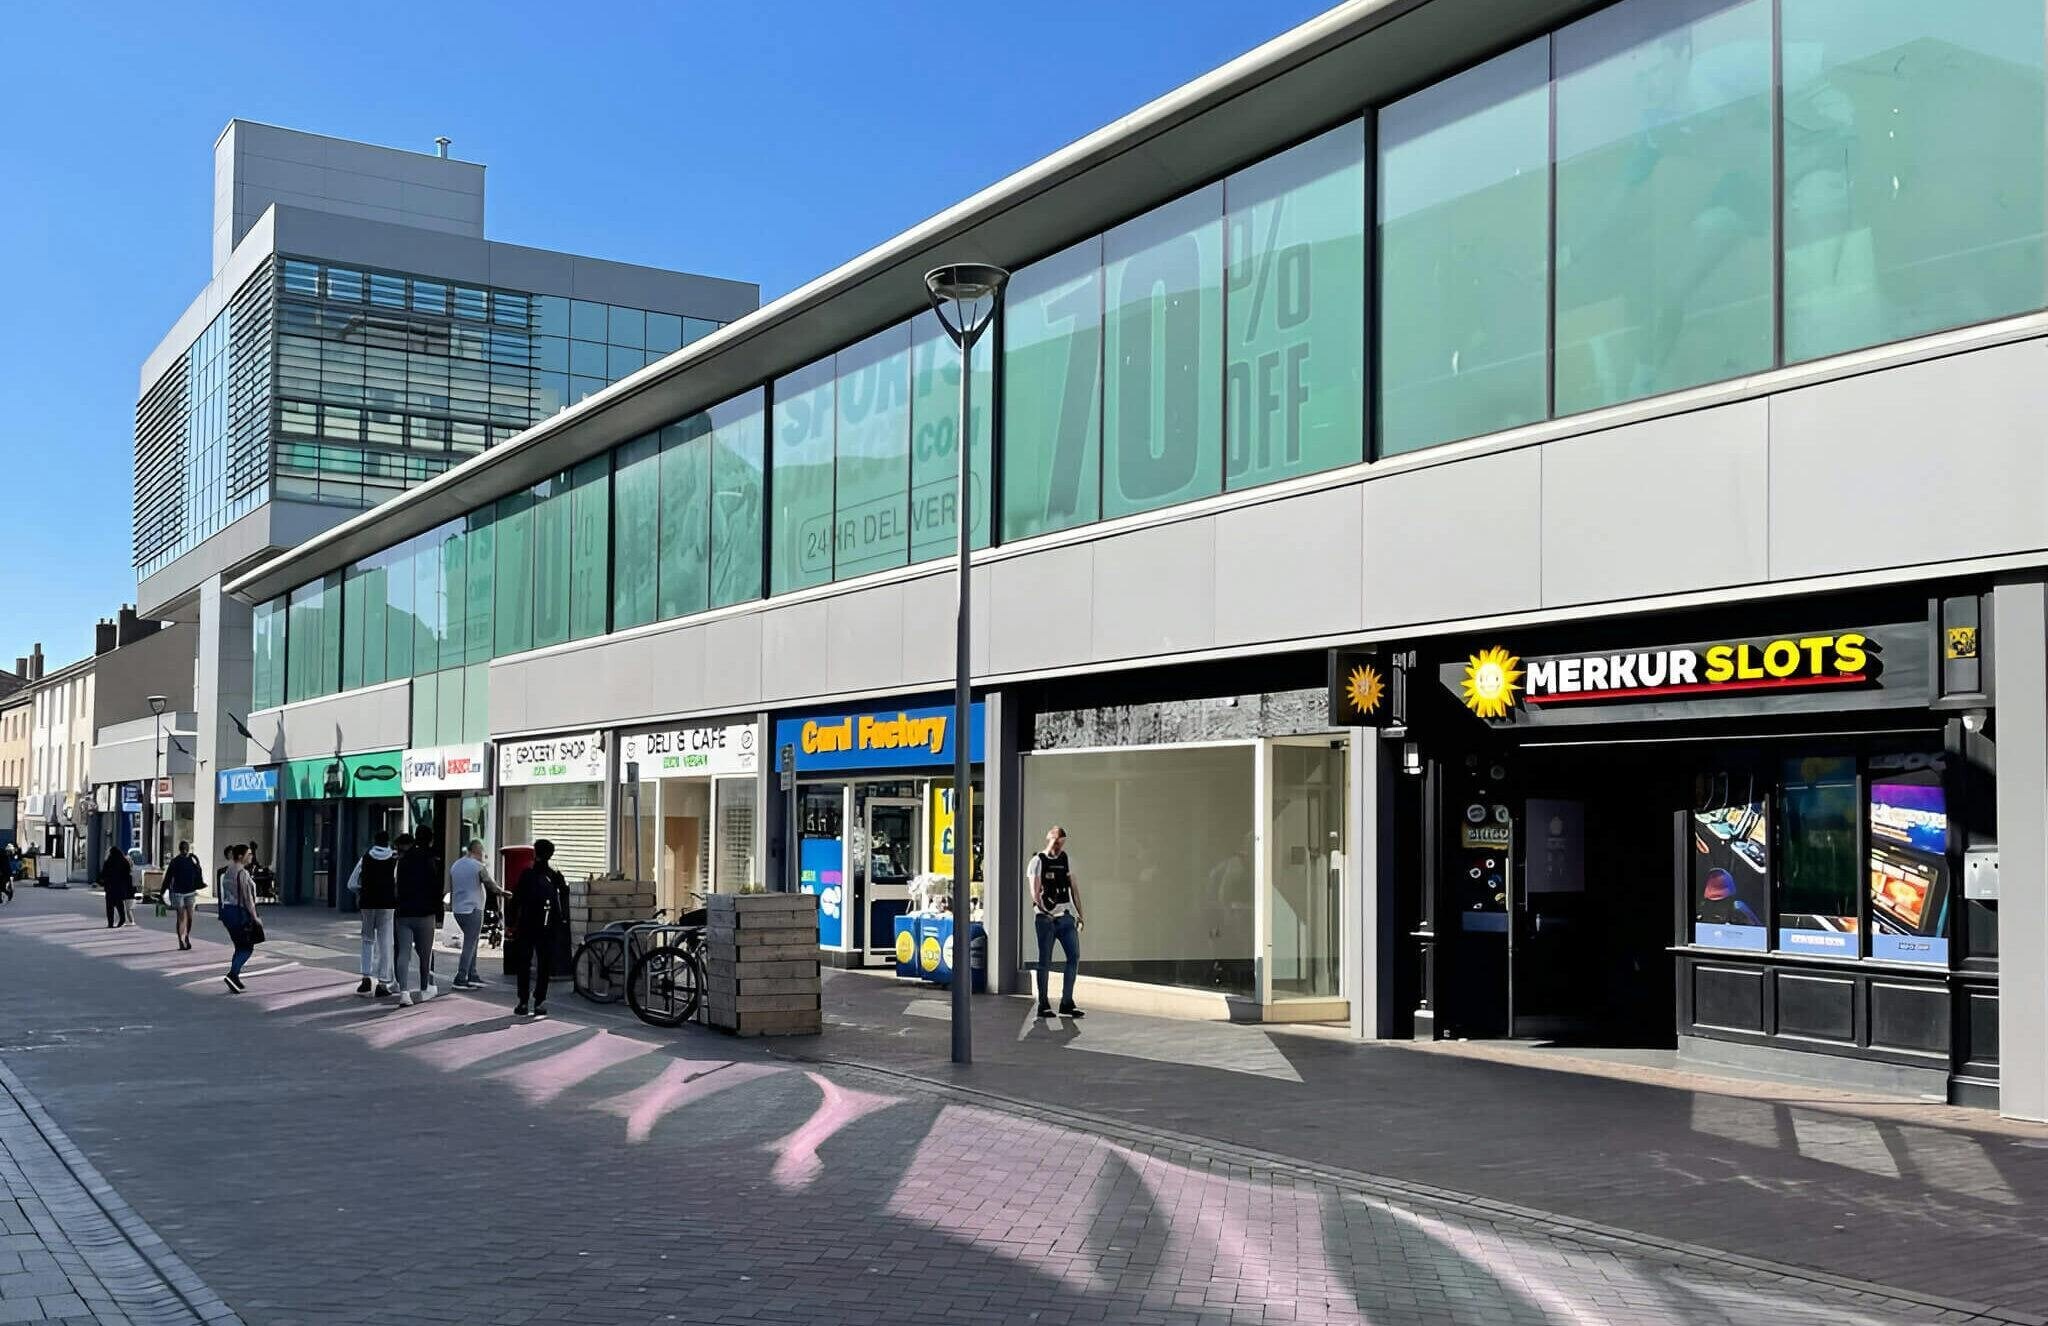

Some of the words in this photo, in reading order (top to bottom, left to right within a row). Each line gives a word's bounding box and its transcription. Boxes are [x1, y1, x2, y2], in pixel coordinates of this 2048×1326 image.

[1226, 341, 1310, 479] OFF
[863, 492, 962, 545] DELVER
[1526, 649, 1698, 695] MERKUR
[1705, 633, 1867, 682] SLOTS
[647, 734, 672, 755] DELI
[802, 716, 852, 754] Card
[858, 711, 948, 754] Factory
